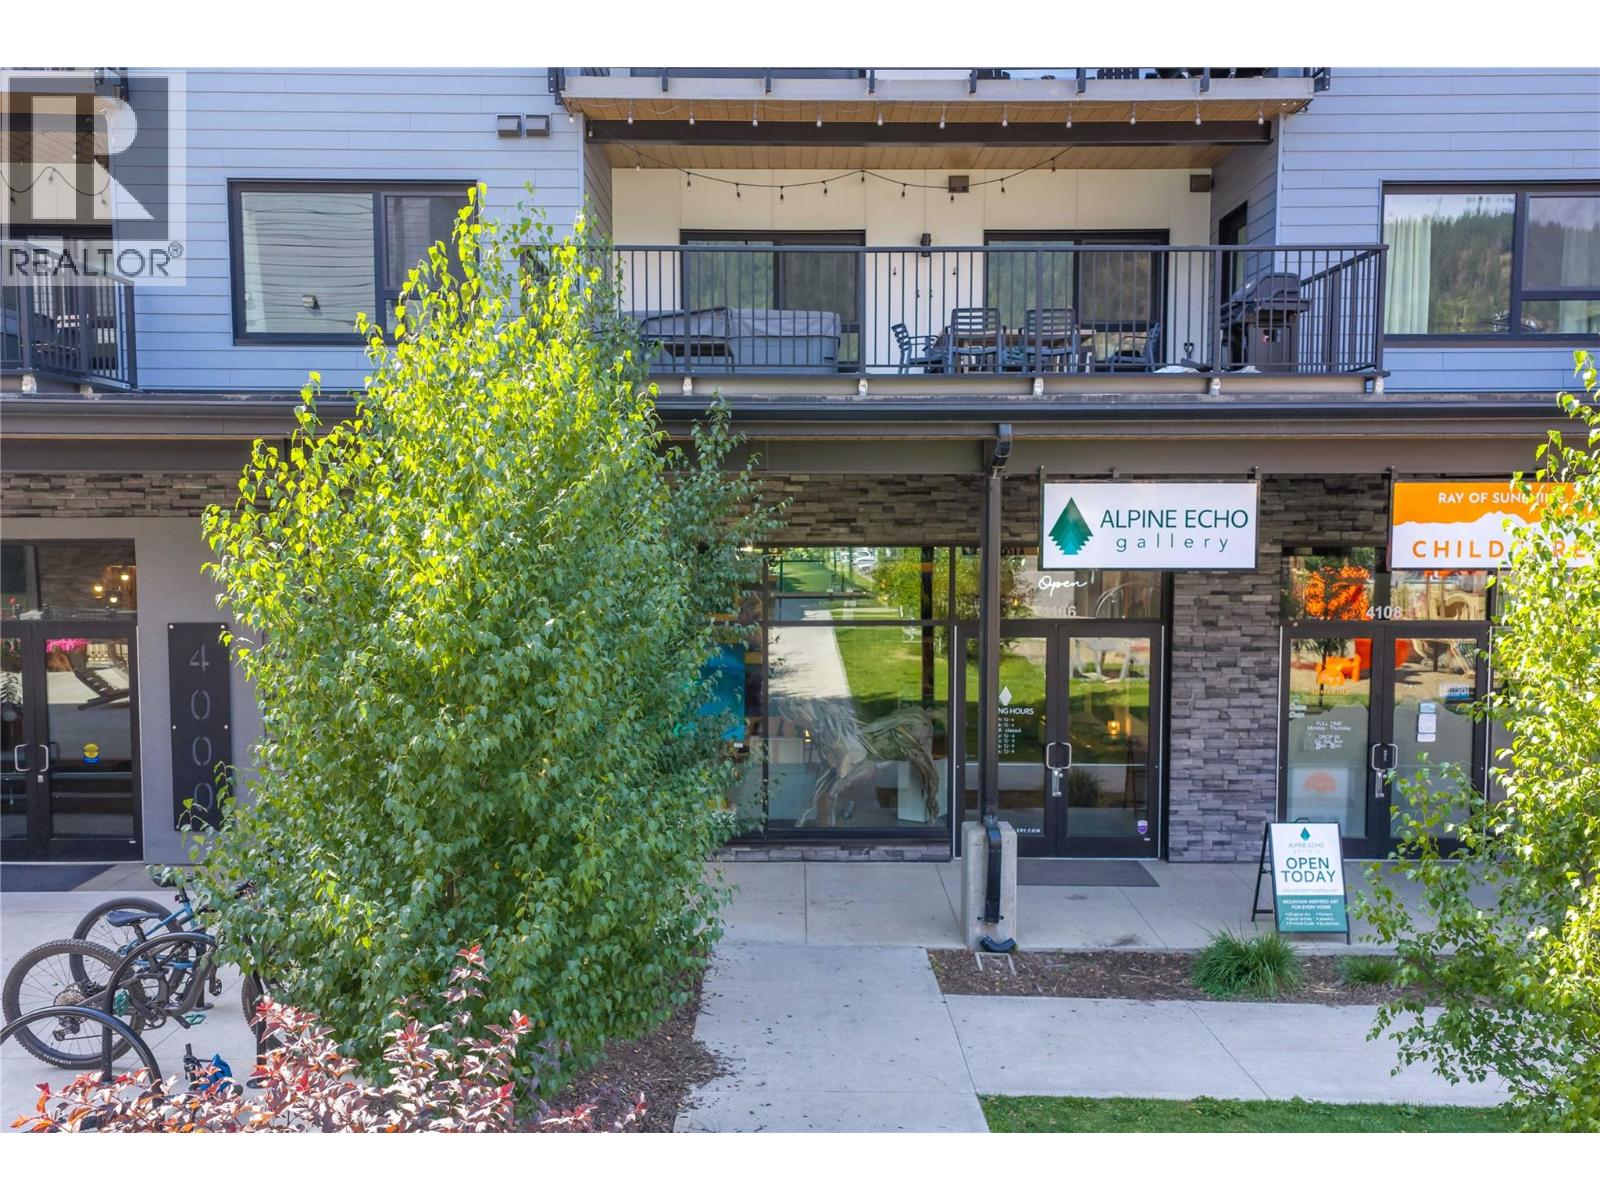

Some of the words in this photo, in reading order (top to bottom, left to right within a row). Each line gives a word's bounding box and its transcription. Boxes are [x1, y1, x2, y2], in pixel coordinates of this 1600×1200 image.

[1438, 492, 1464, 504] RAY
[1469, 492, 1488, 504] OF
[1100, 509, 1177, 528] ALPINE
[1184, 509, 1249, 528] ECHO
[1116, 533, 1229, 553] gallery
[1412, 540, 1587, 559] CHILDRE
[1038, 575, 1088, 598] Open
[1366, 605, 1402, 619] 4108
[1010, 707, 1034, 715] HOURS
[188, 642, 214, 813] 4000
[1288, 841, 1307, 849] ALPINE
[1308, 841, 1324, 849] ECHO
[1286, 857, 1329, 869] OPEN
[1281, 870, 1335, 882] TODAY
